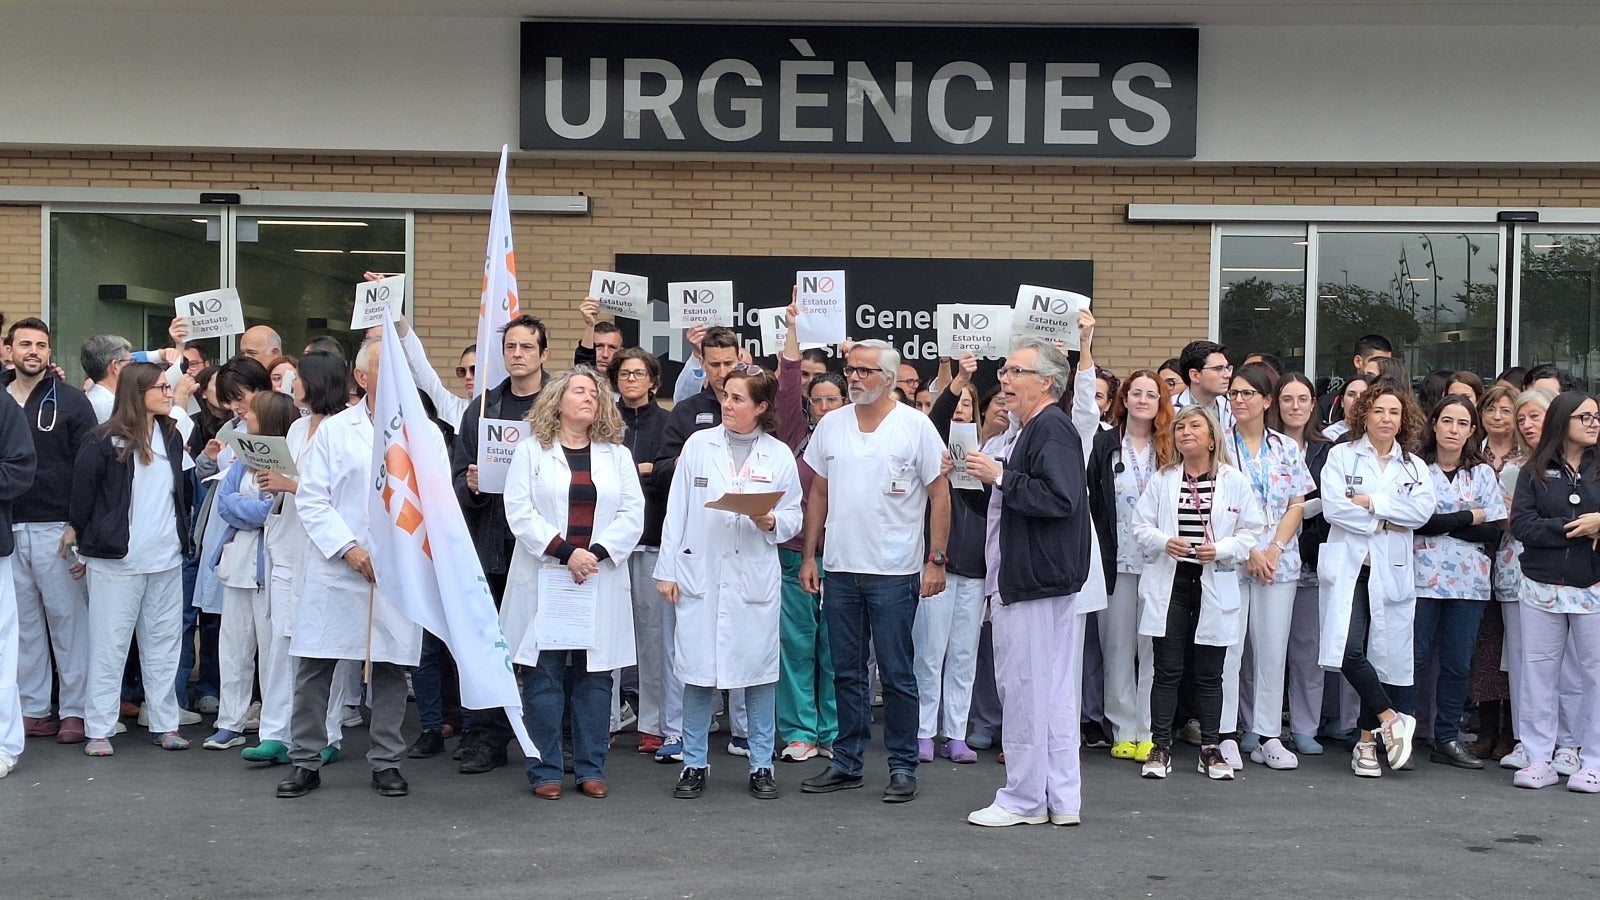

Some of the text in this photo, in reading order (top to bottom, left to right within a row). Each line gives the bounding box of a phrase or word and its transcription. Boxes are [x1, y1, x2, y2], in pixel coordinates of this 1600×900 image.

[545, 38, 1172, 145] URGÈNCIES
[600, 297, 632, 307] Estatuto
[192, 316, 228, 327] Estatuto
[1029, 314, 1068, 327] Estatuto
[952, 334, 992, 342] Estatuto
